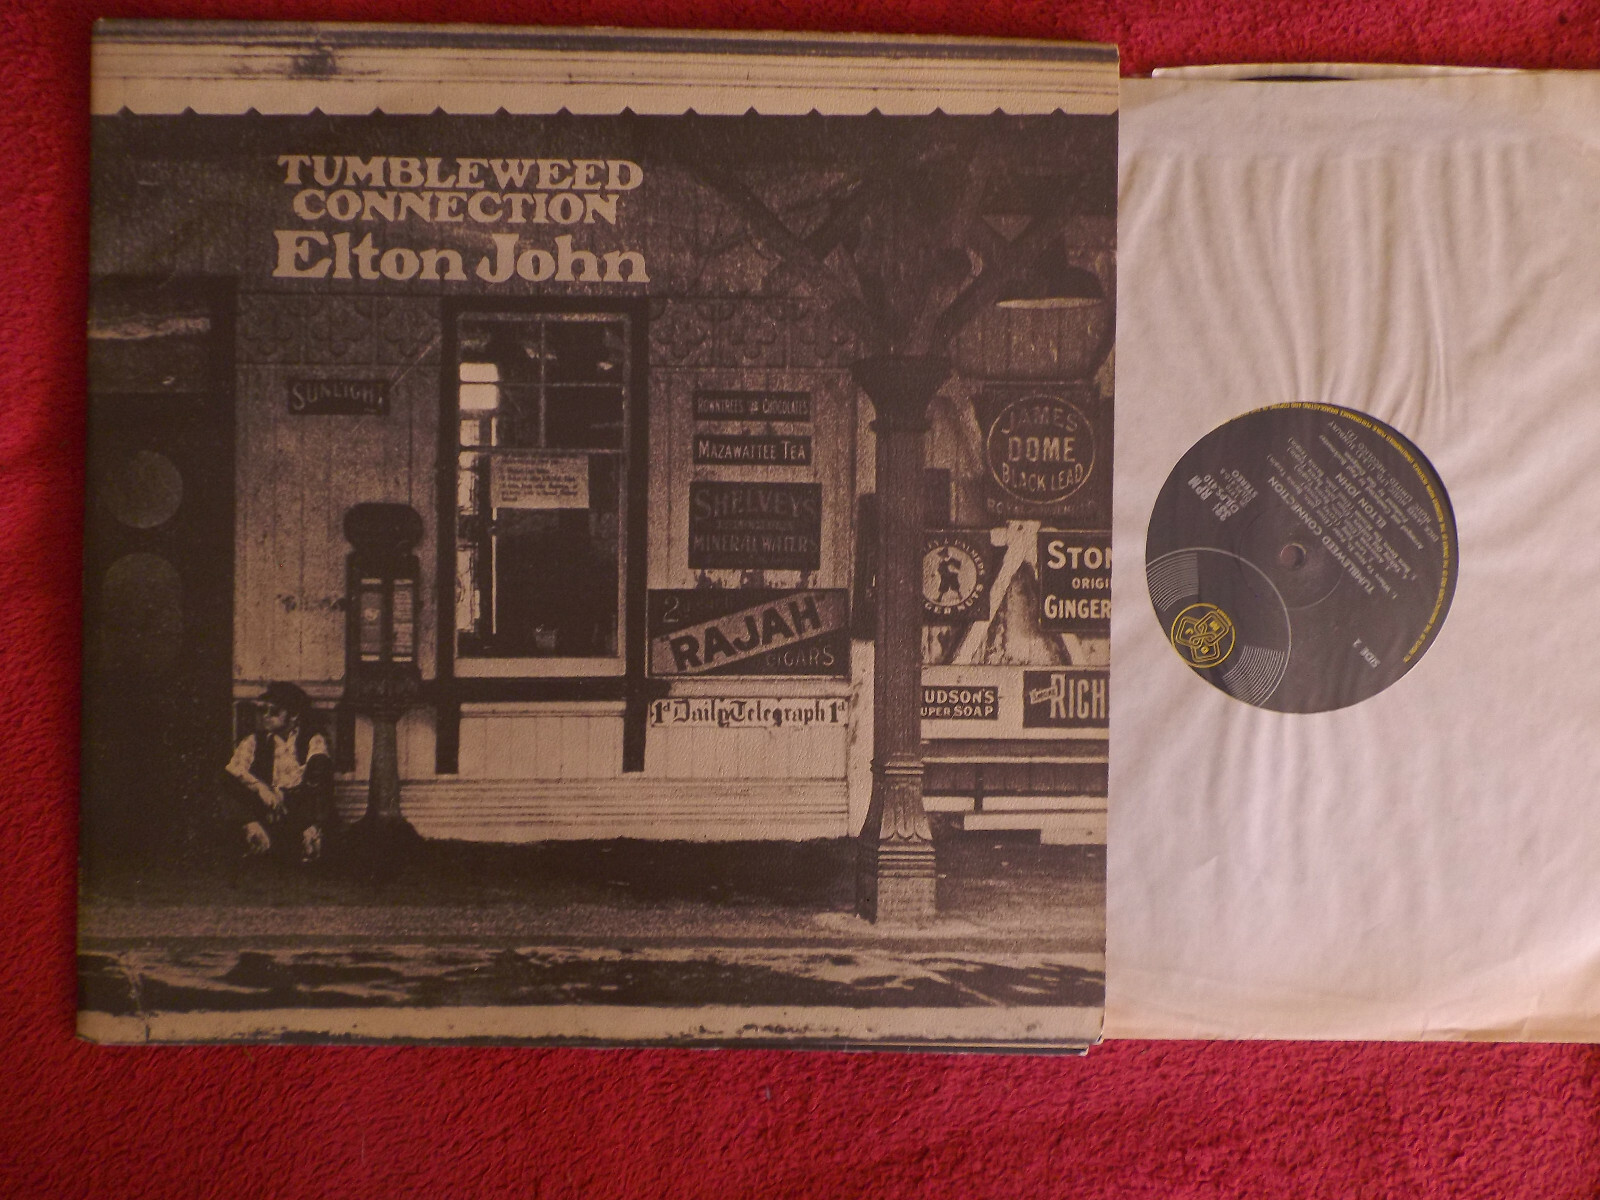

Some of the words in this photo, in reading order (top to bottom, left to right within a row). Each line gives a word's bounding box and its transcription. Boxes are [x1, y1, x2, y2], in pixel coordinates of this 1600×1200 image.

[277, 155, 644, 191] TUMBLEWEED
[293, 189, 620, 225] CONNECTION
[272, 230, 467, 280] Elton
[475, 233, 651, 283] John
[1001, 406, 1078, 434] JAMES
[698, 439, 776, 460] MAZAWATTEE
[781, 440, 807, 460] TEA
[1008, 436, 1076, 463] DOME
[1001, 462, 1046, 492] BLACK
[1050, 463, 1084, 491] LEAD
[1230, 468, 1258, 498] STEREO
[1334, 470, 1361, 498] JOHN
[1267, 474, 1323, 536] CONNECTION
[1357, 496, 1387, 529] ELTON
[1320, 533, 1376, 594] TUMBLEWEED
[1044, 594, 1111, 619] GINGER
[1359, 645, 1381, 668] SIDE
[922, 688, 995, 704] UDSON'S
[1049, 673, 1106, 719] RICH
[673, 699, 730, 728] Daily
[730, 699, 825, 727] Telegraph
[953, 706, 993, 717] SOAP
